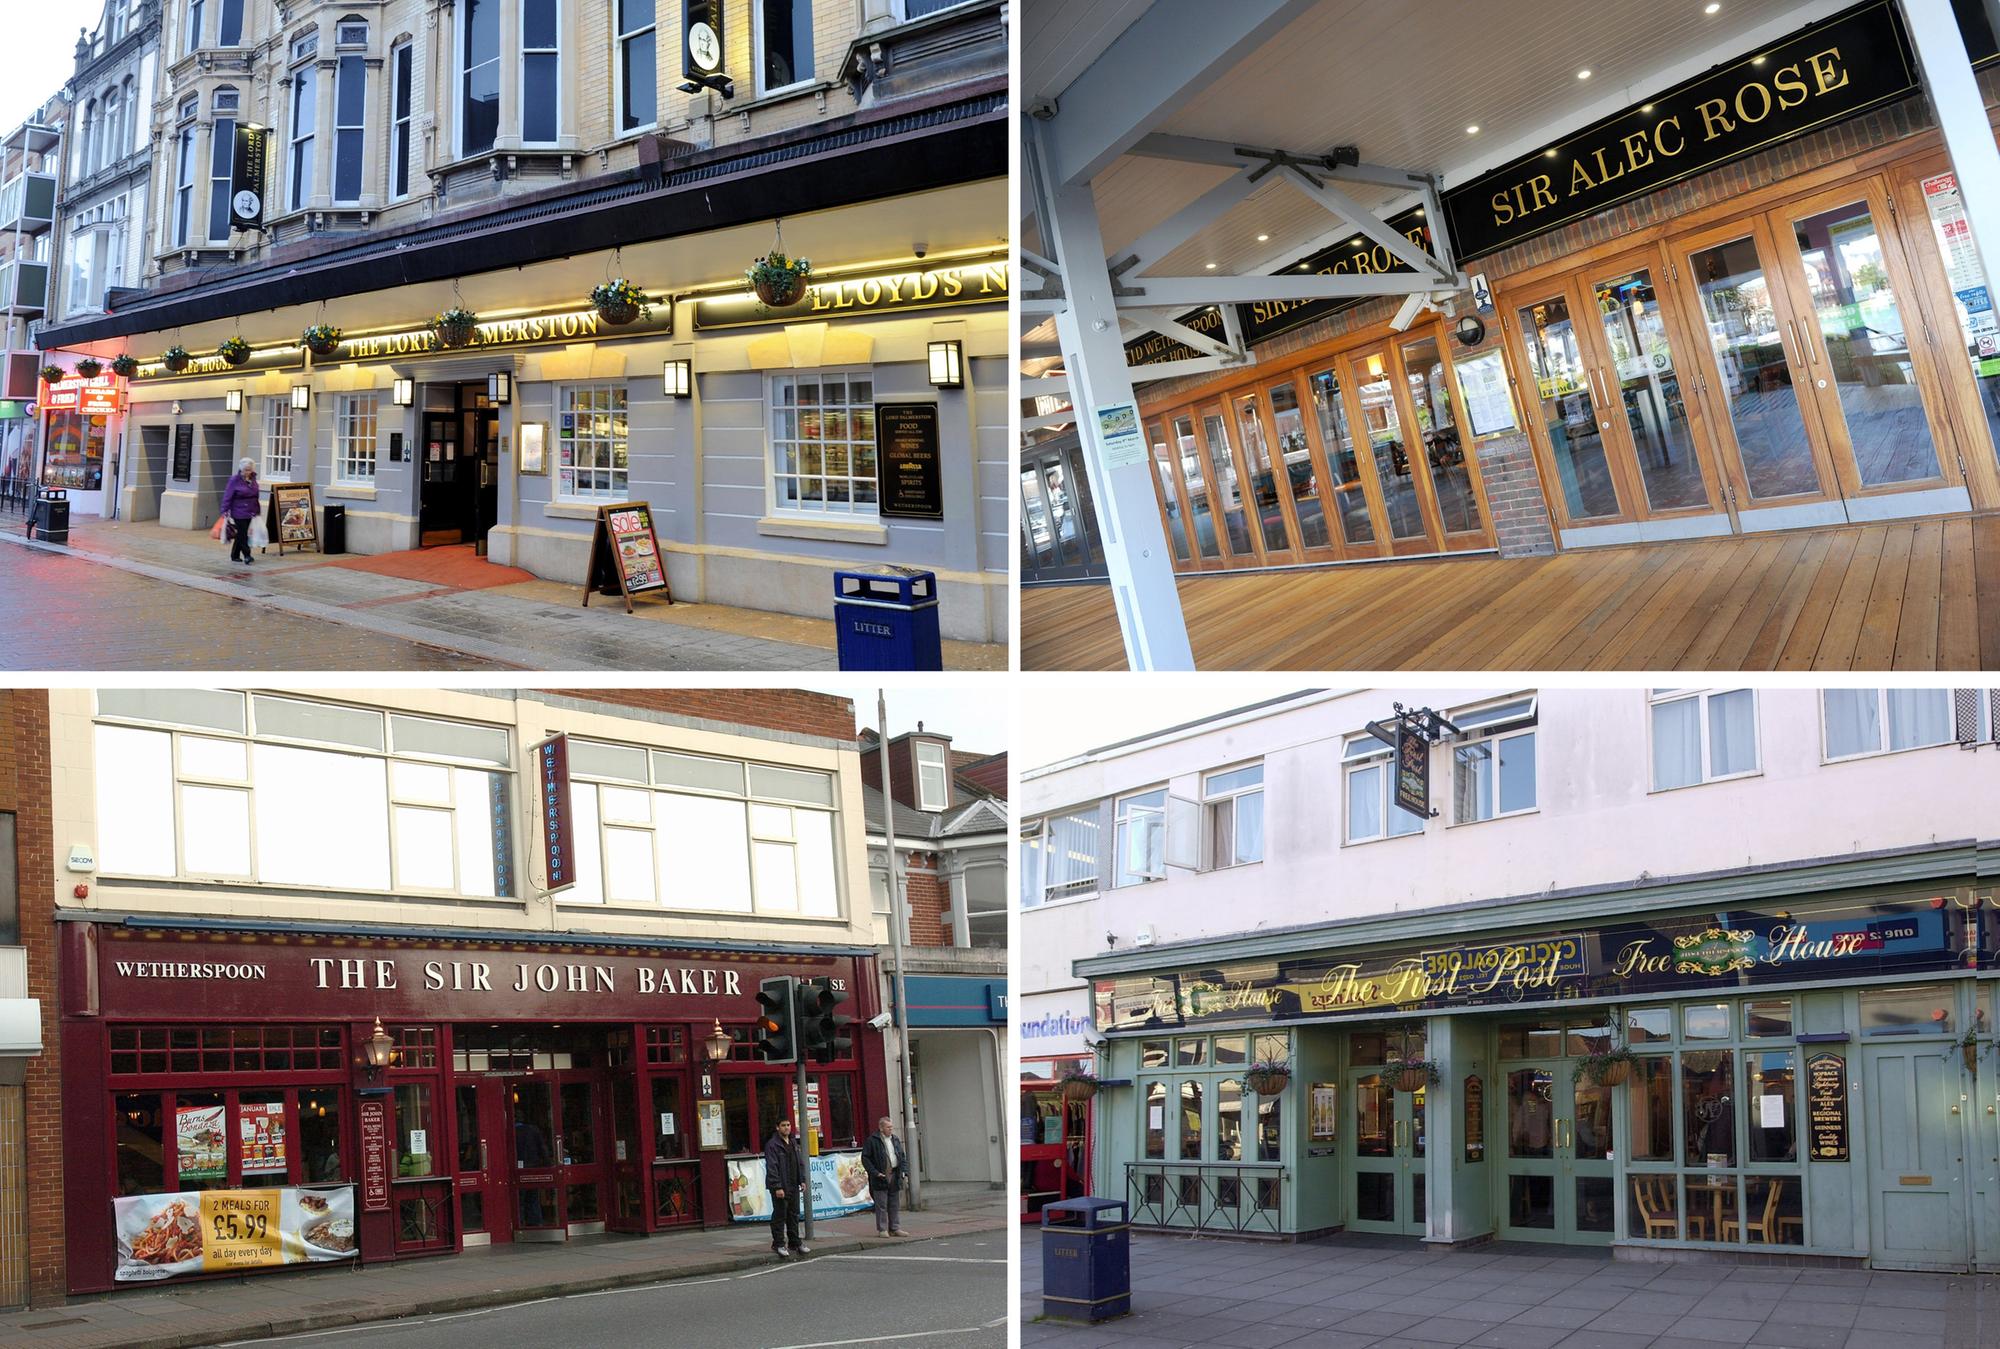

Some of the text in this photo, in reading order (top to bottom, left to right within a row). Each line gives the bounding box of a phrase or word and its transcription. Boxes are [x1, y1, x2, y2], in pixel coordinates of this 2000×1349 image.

[247, 133, 255, 157] LORD
[1491, 47, 1850, 226] SIR ALEC ROSE
[253, 134, 262, 193] PALMERSTON
[811, 269, 963, 311] LLOYDS
[348, 336, 379, 358] THE
[854, 621, 891, 636] LITTER
[543, 744, 562, 881] WETHERSPOON
[1612, 924, 1865, 978] Free House
[116, 958, 742, 996] WETHERSPOON THE SIR JOHN BAKER
[1318, 944, 1562, 1005] The First Post
[1226, 980, 1283, 1009] House
[179, 1114, 206, 1126] Burns
[240, 1105, 266, 1113] JANUARY
[180, 1119, 220, 1133] Bonanza
[213, 1200, 269, 1211] 2 MEALS FOR
[213, 1214, 267, 1242] £5.99
[212, 1246, 272, 1260] all day every day
